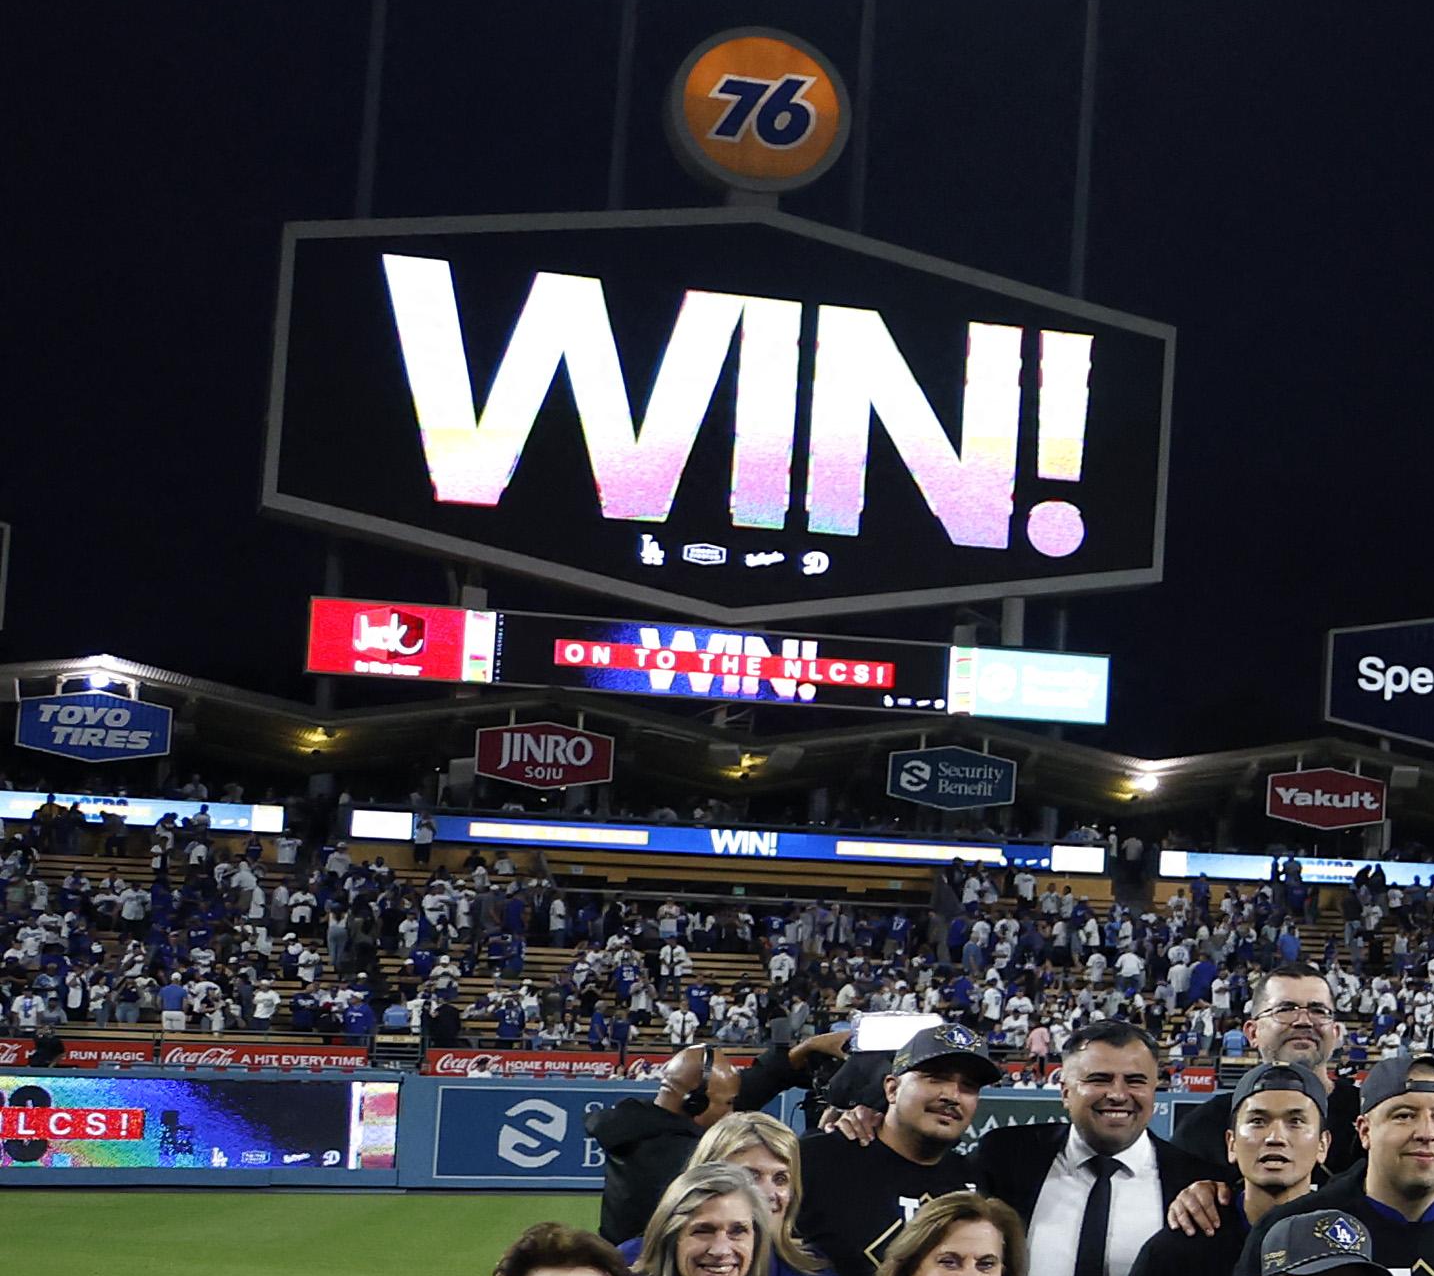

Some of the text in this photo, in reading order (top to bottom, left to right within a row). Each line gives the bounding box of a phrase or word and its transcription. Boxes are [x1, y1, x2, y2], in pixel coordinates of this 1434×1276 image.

[707, 71, 819, 149] 76
[382, 254, 1094, 557] WIN!
[564, 643, 885, 684] ON TO THE NLCS!
[39, 704, 130, 727] TOYO
[52, 726, 152, 749] TIRES
[497, 732, 592, 769] JINRO
[938, 762, 1003, 783] Security
[938, 779, 992, 796] Benefit
[1275, 787, 1379, 809] Yakult
[711, 829, 777, 856] WIN!
[70, 1051, 144, 1064] RUN MAGIC
[165, 1047, 365, 1067] Coca-Cola A HIT EVERY TIME
[506, 1061, 542, 1072] HOME
[545, 1061, 570, 1071] RUN
[572, 1062, 614, 1072] MAGIC
[1183, 1075, 1212, 1085] TIME
[0, 1112, 129, 1136] LCS!
